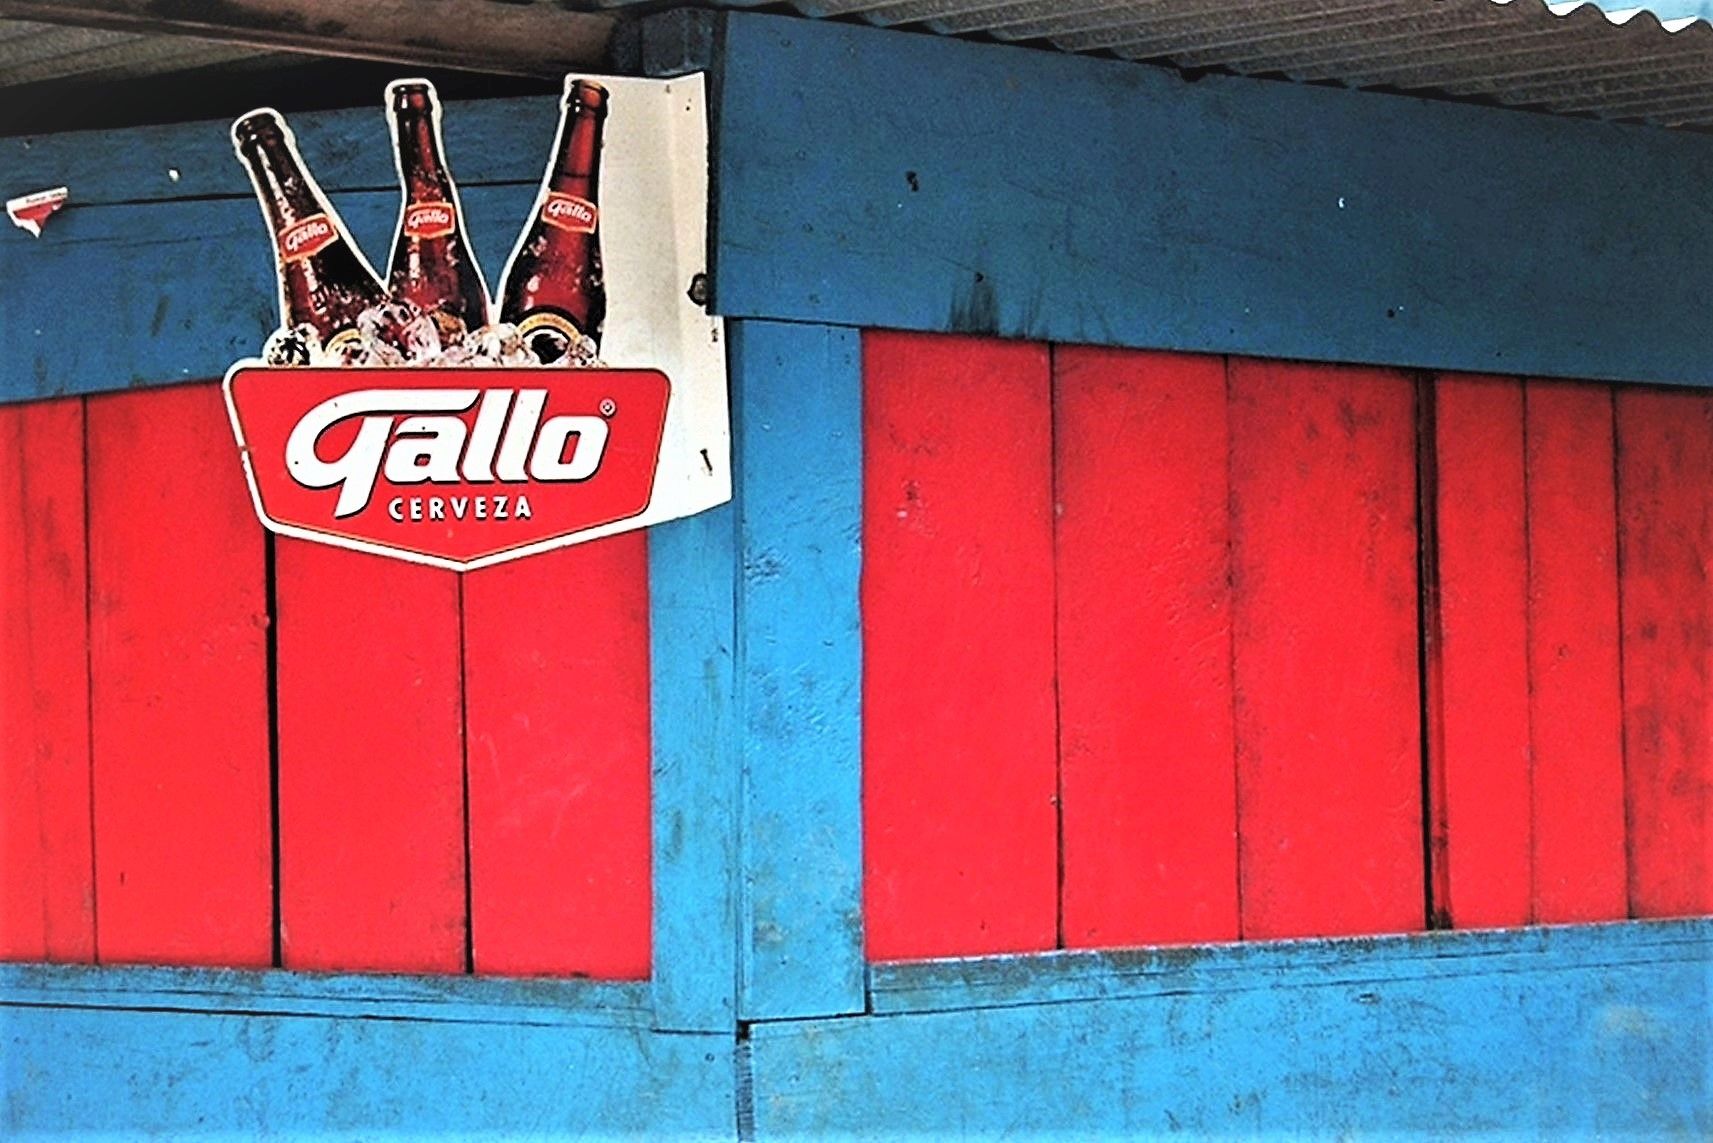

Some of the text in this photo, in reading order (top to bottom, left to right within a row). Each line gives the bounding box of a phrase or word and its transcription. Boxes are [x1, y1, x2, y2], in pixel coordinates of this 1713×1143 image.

[407, 209, 449, 229] Gallo
[547, 199, 592, 222] Gallo
[285, 222, 329, 251] Gallo
[285, 388, 609, 518] Gallo
[388, 496, 532, 520] CERVEZA
